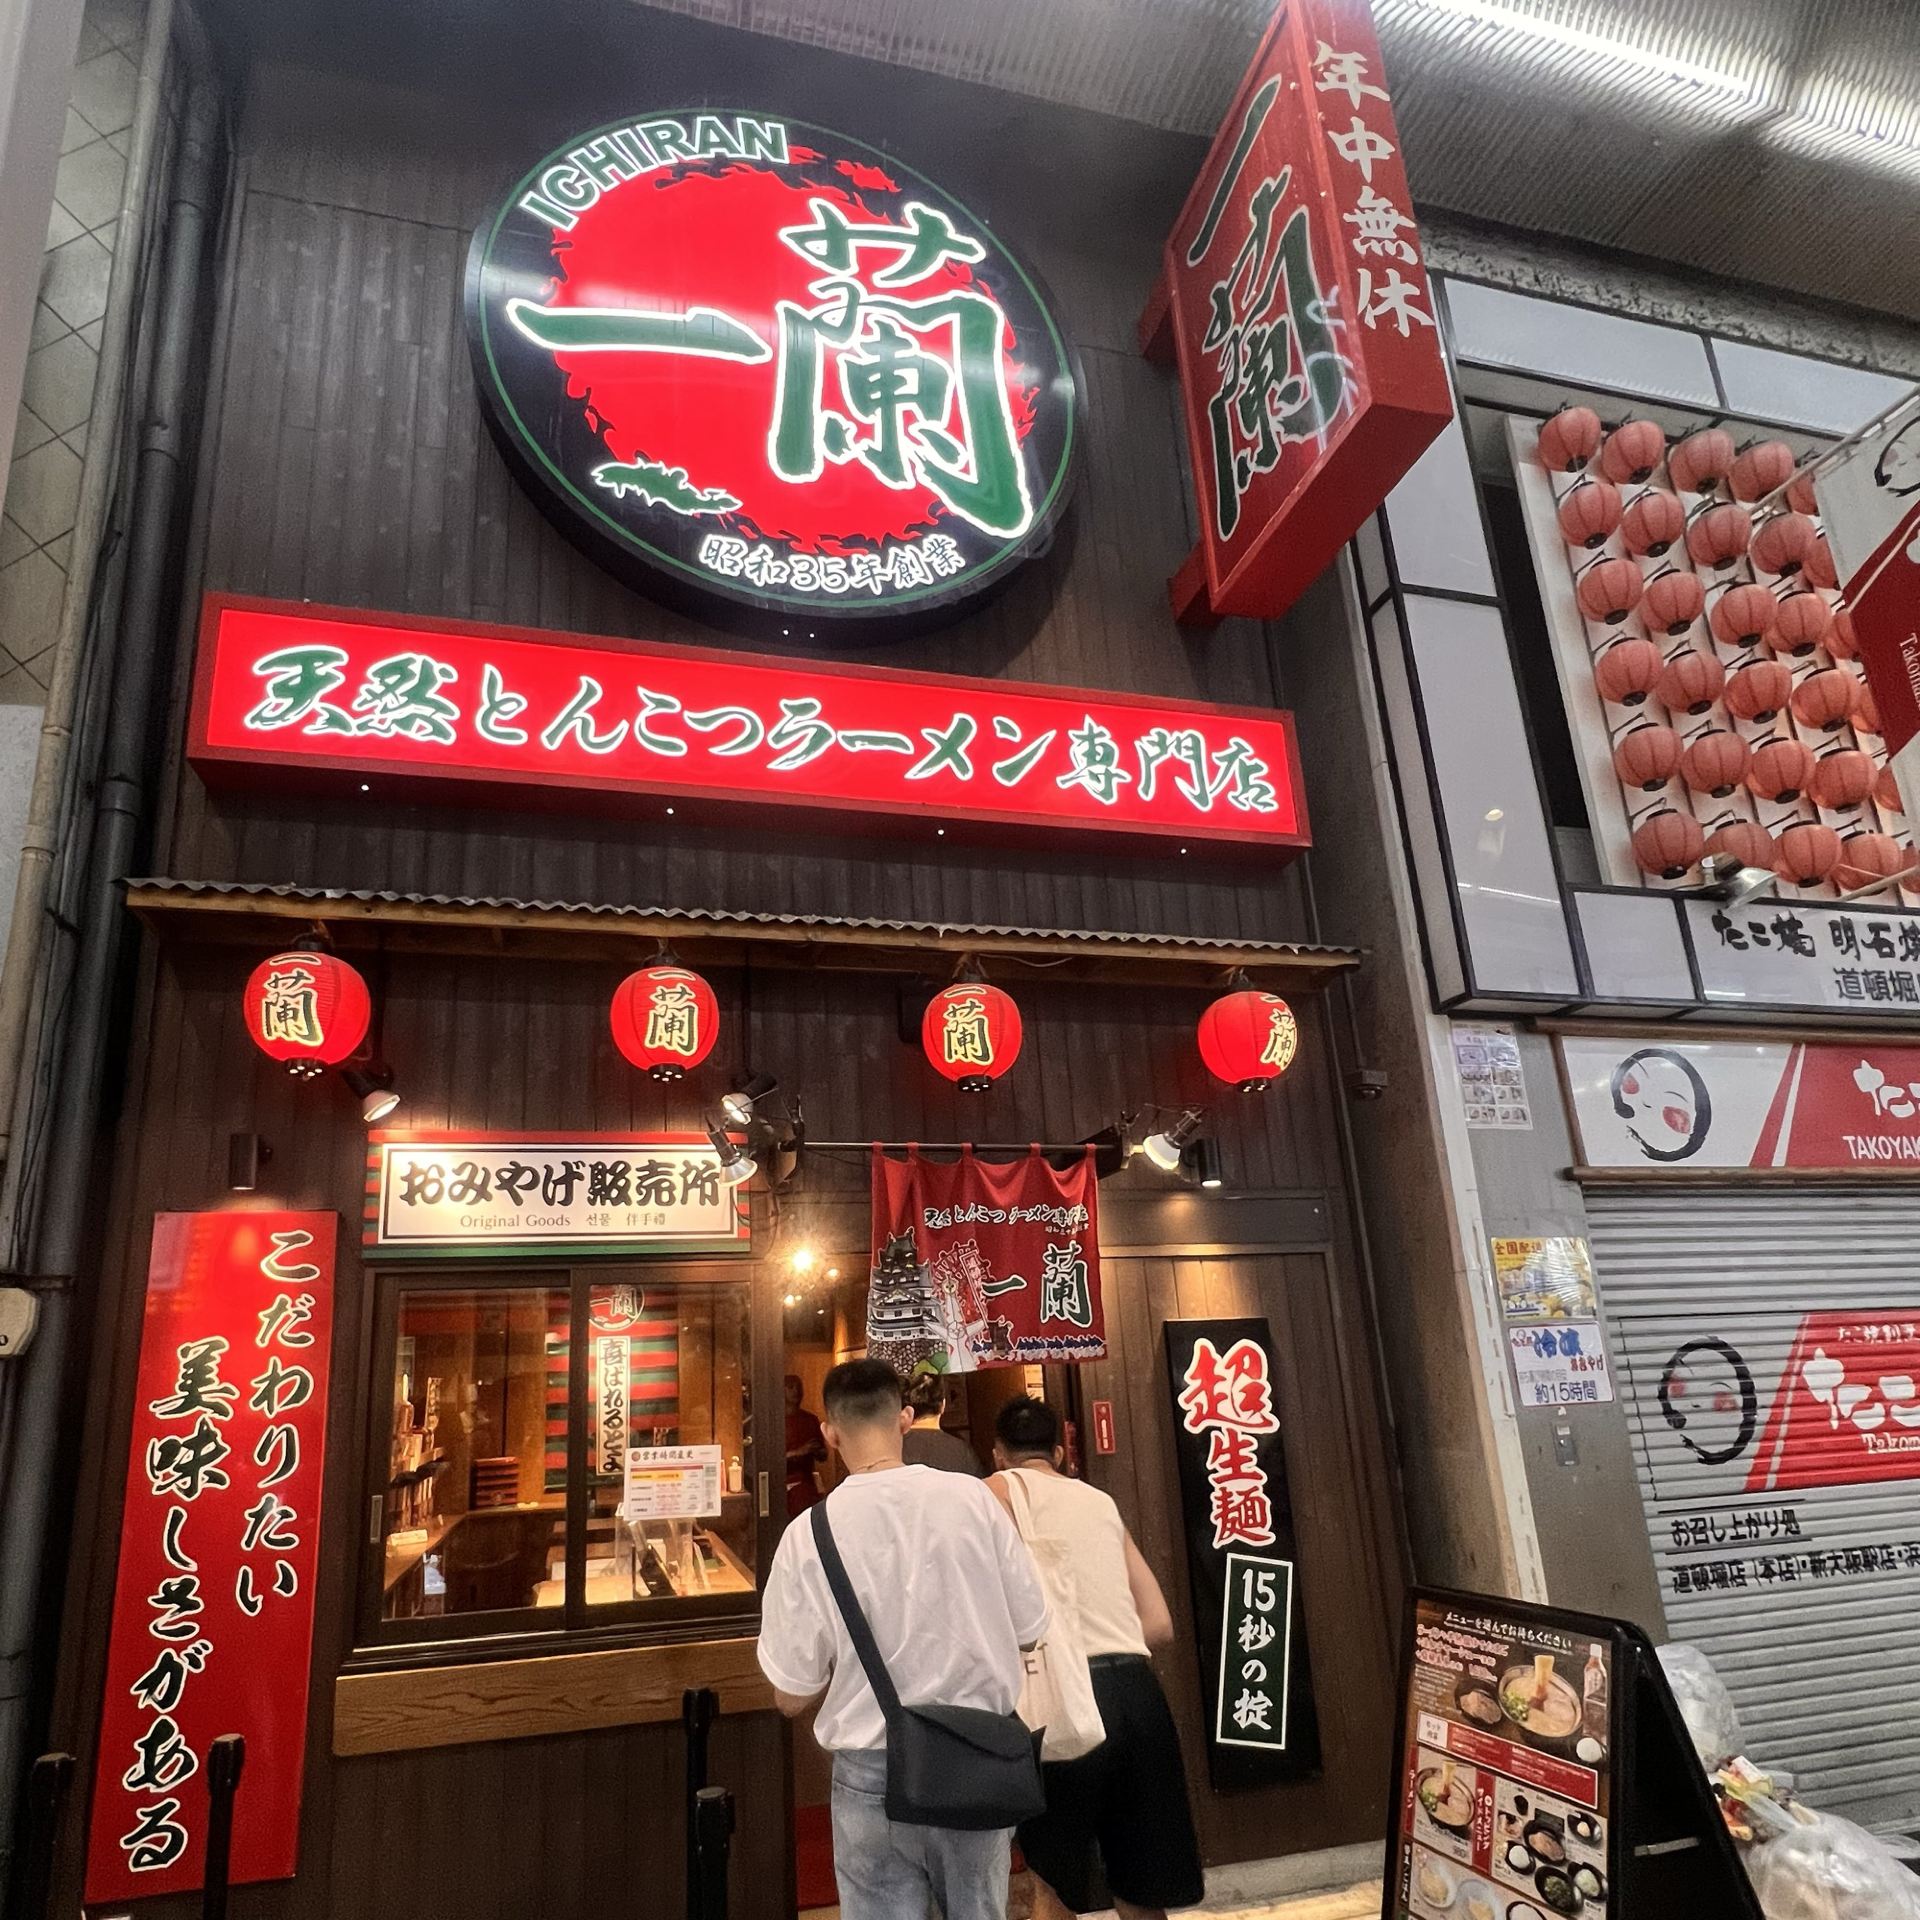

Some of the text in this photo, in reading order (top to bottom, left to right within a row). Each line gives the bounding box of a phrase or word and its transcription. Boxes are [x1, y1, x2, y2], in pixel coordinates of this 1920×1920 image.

[519, 115, 790, 232] ICHIRAN
[1305, 40, 1435, 338] 年中無休
[1186, 73, 1346, 542] 一蘭
[506, 198, 1033, 538] 一蘭
[699, 532, 966, 596] 昭和35年創業
[243, 644, 1279, 814] 天然とんこつラーメン専門店
[261, 952, 324, 1046] 一蘭
[644, 967, 699, 1056] 一蘭
[943, 985, 995, 1066] 一蘭
[1260, 993, 1298, 1070] 一蘭
[399, 1158, 721, 1207] おみやげ販売所
[459, 1213, 571, 1230] Original Goods
[586, 1213, 612, 1227] 선물
[982, 1240, 1092, 1328] 一蘭
[235, 1230, 320, 1616] こだわりたい
[1534, 1380, 1598, 1403] 約15時間
[1178, 1337, 1280, 1549] 超生麺
[1671, 1508, 1801, 1547] お召し上がり処
[120, 1335, 239, 1873] 美味しさがある
[1232, 1568, 1277, 1731] 15秒の掟
